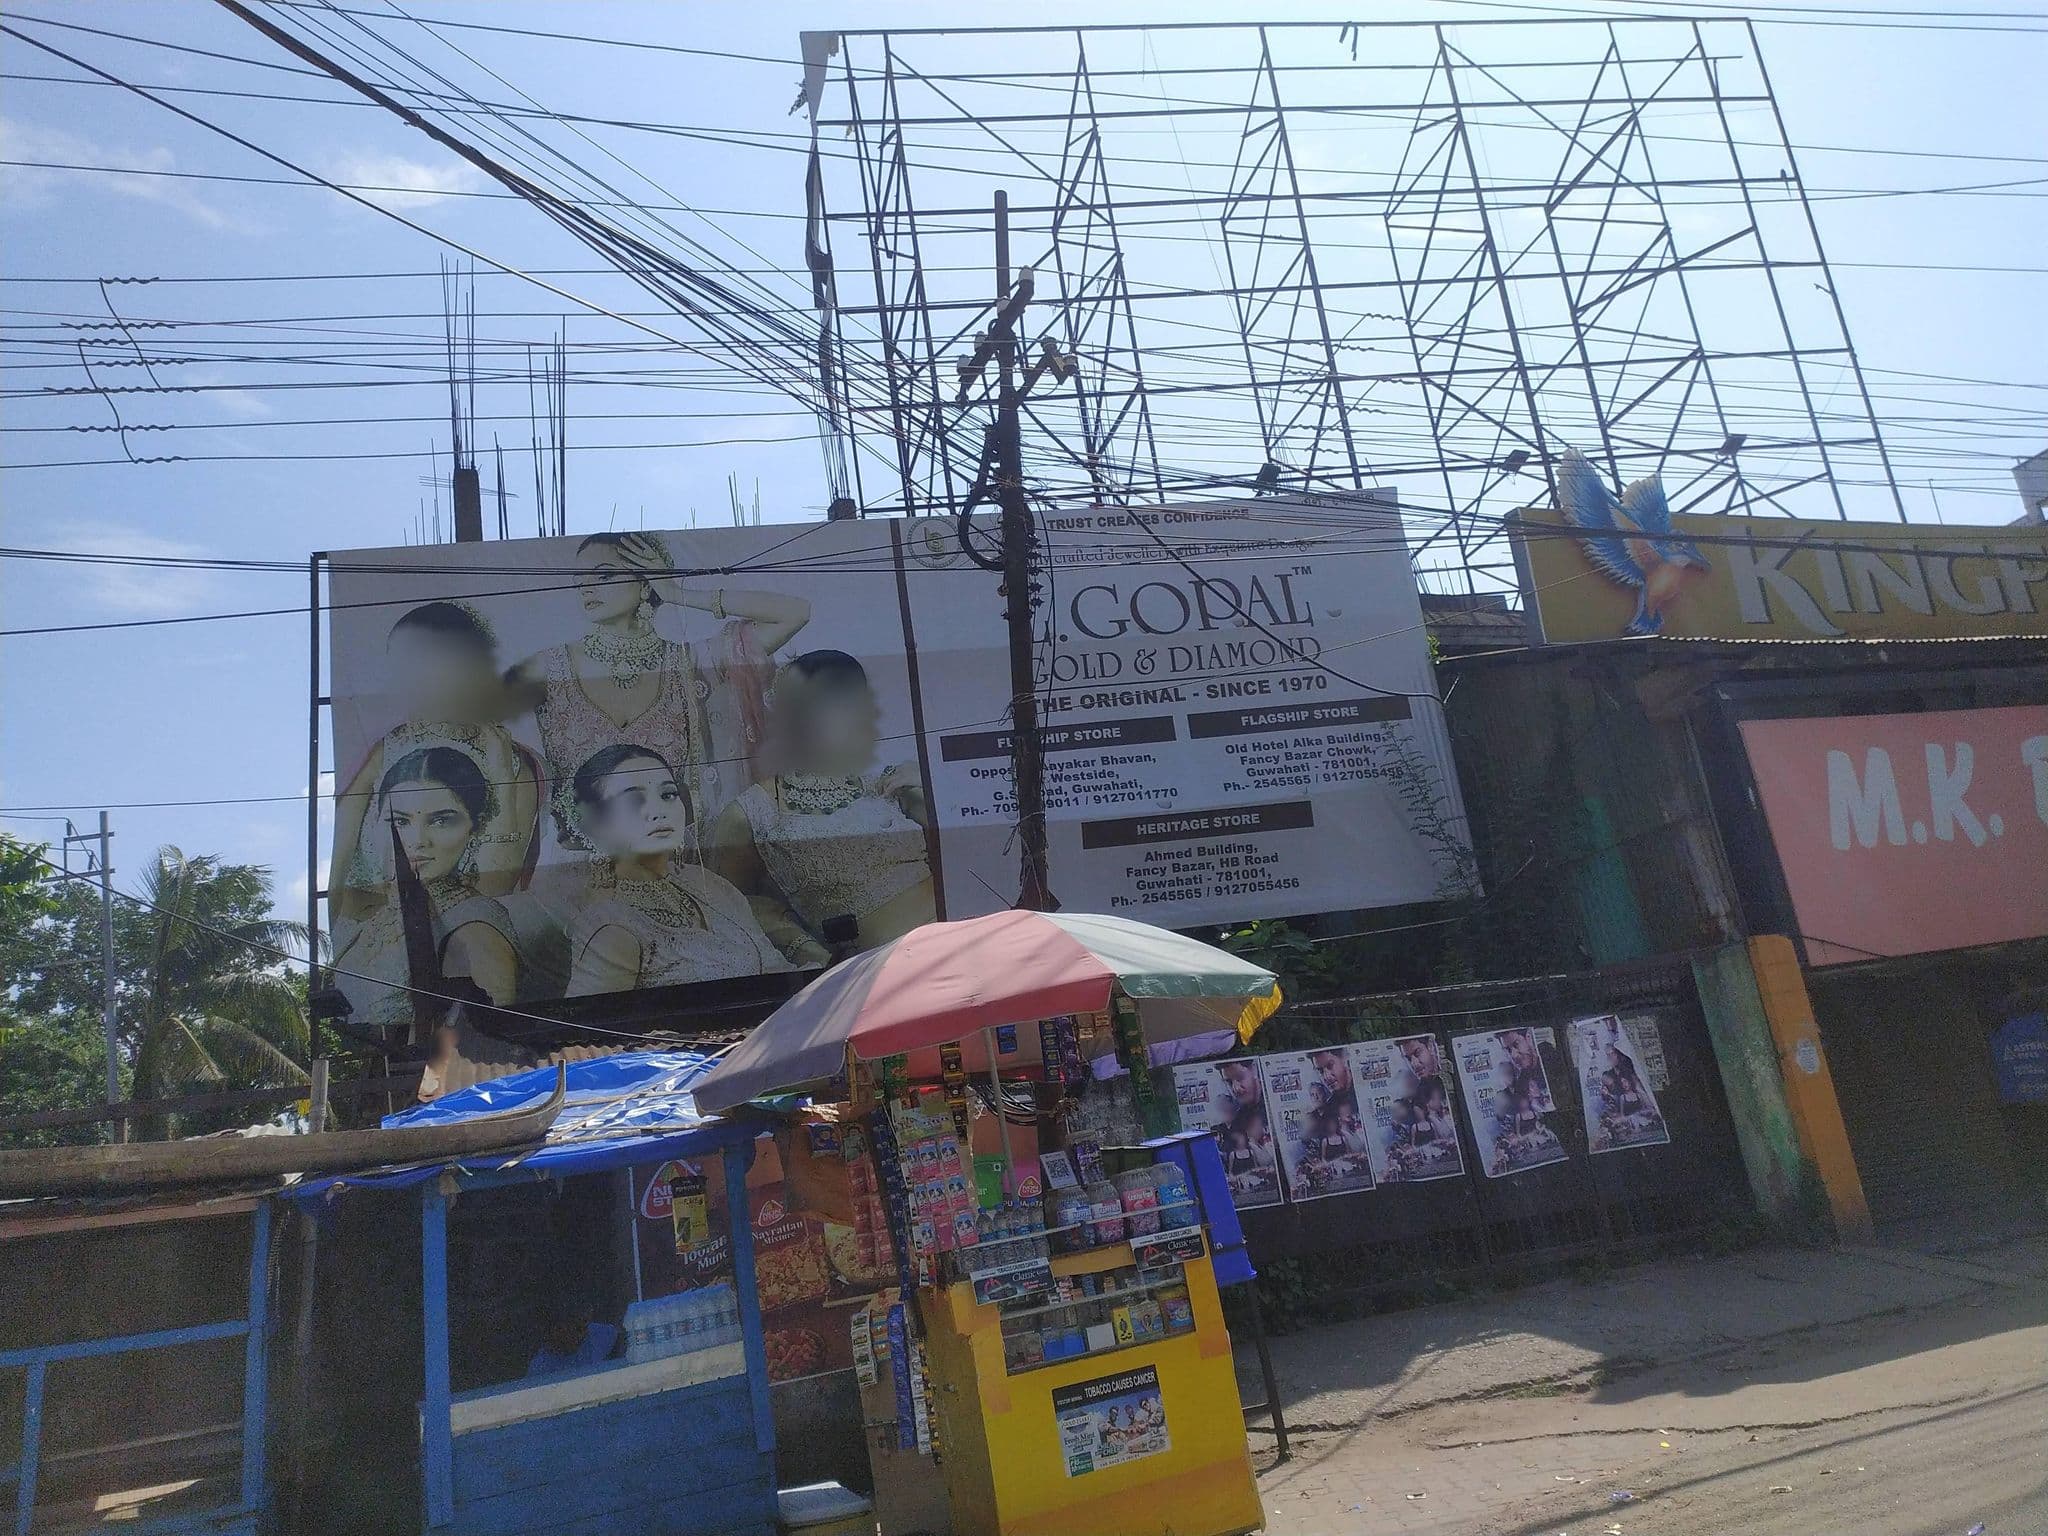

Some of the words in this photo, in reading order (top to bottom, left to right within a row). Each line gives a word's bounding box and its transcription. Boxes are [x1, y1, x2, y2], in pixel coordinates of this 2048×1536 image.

[1047, 517, 1092, 531] TRUST
[1097, 513, 1160, 528] CREATES
[1163, 508, 1250, 525] CONFIDENCE
[1032, 650, 1122, 685] GOLD
[1134, 648, 1157, 675] &
[1170, 636, 1322, 673] DIAMOND
[1034, 695, 1073, 714] THE
[1080, 687, 1187, 710] ORIGINAL
[1206, 679, 1272, 700] SINCE
[1279, 674, 1329, 692] 1970
[1240, 711, 1309, 727] FLAGSHIP
[1313, 706, 1359, 720] STORE
[1074, 727, 1122, 742] STORE
[1225, 743, 1248, 754] Old
[1252, 739, 1289, 752] Hotel
[1293, 736, 1323, 748] Alka
[1327, 732, 1387, 746] Building,
[1101, 753, 1157, 767] Bhavan,
[1240, 754, 1281, 768] Fancy
[1285, 751, 1323, 762] Bazar
[1327, 746, 1377, 759] Chowk,
[1246, 763, 1311, 778] Guwahati
[1323, 757, 1376, 772] 781001,
[1050, 769, 1120, 785] Westside,
[1072, 779, 1143, 795] Guwahati,
[1223, 781, 1250, 793] Ph.-
[1253, 775, 1311, 790] 2545565
[961, 805, 989, 817] Ph.-
[1094, 787, 1178, 804] 9127011770
[1827, 742, 2005, 851] M.K.
[1136, 818, 1209, 836] HERITAGE
[1213, 813, 1261, 828] STORE
[1144, 848, 1193, 862] Ahmed
[1197, 843, 1258, 857] Building,
[1126, 865, 1168, 879] Fancy
[1172, 861, 1215, 874] Bazar,
[1219, 857, 1240, 868] HB
[1244, 852, 1279, 865] Road
[1136, 875, 1203, 891] Guwahati
[1216, 868, 1272, 883] 781001,
[1110, 895, 1138, 908] Ph.-
[1141, 888, 1202, 905] 2545565
[1215, 877, 1300, 896] 9127055456
[1084, 1384, 1111, 1398] TOBACCO
[1111, 1378, 1133, 1393] CAUSES
[1134, 1371, 1156, 1386] CANCER
